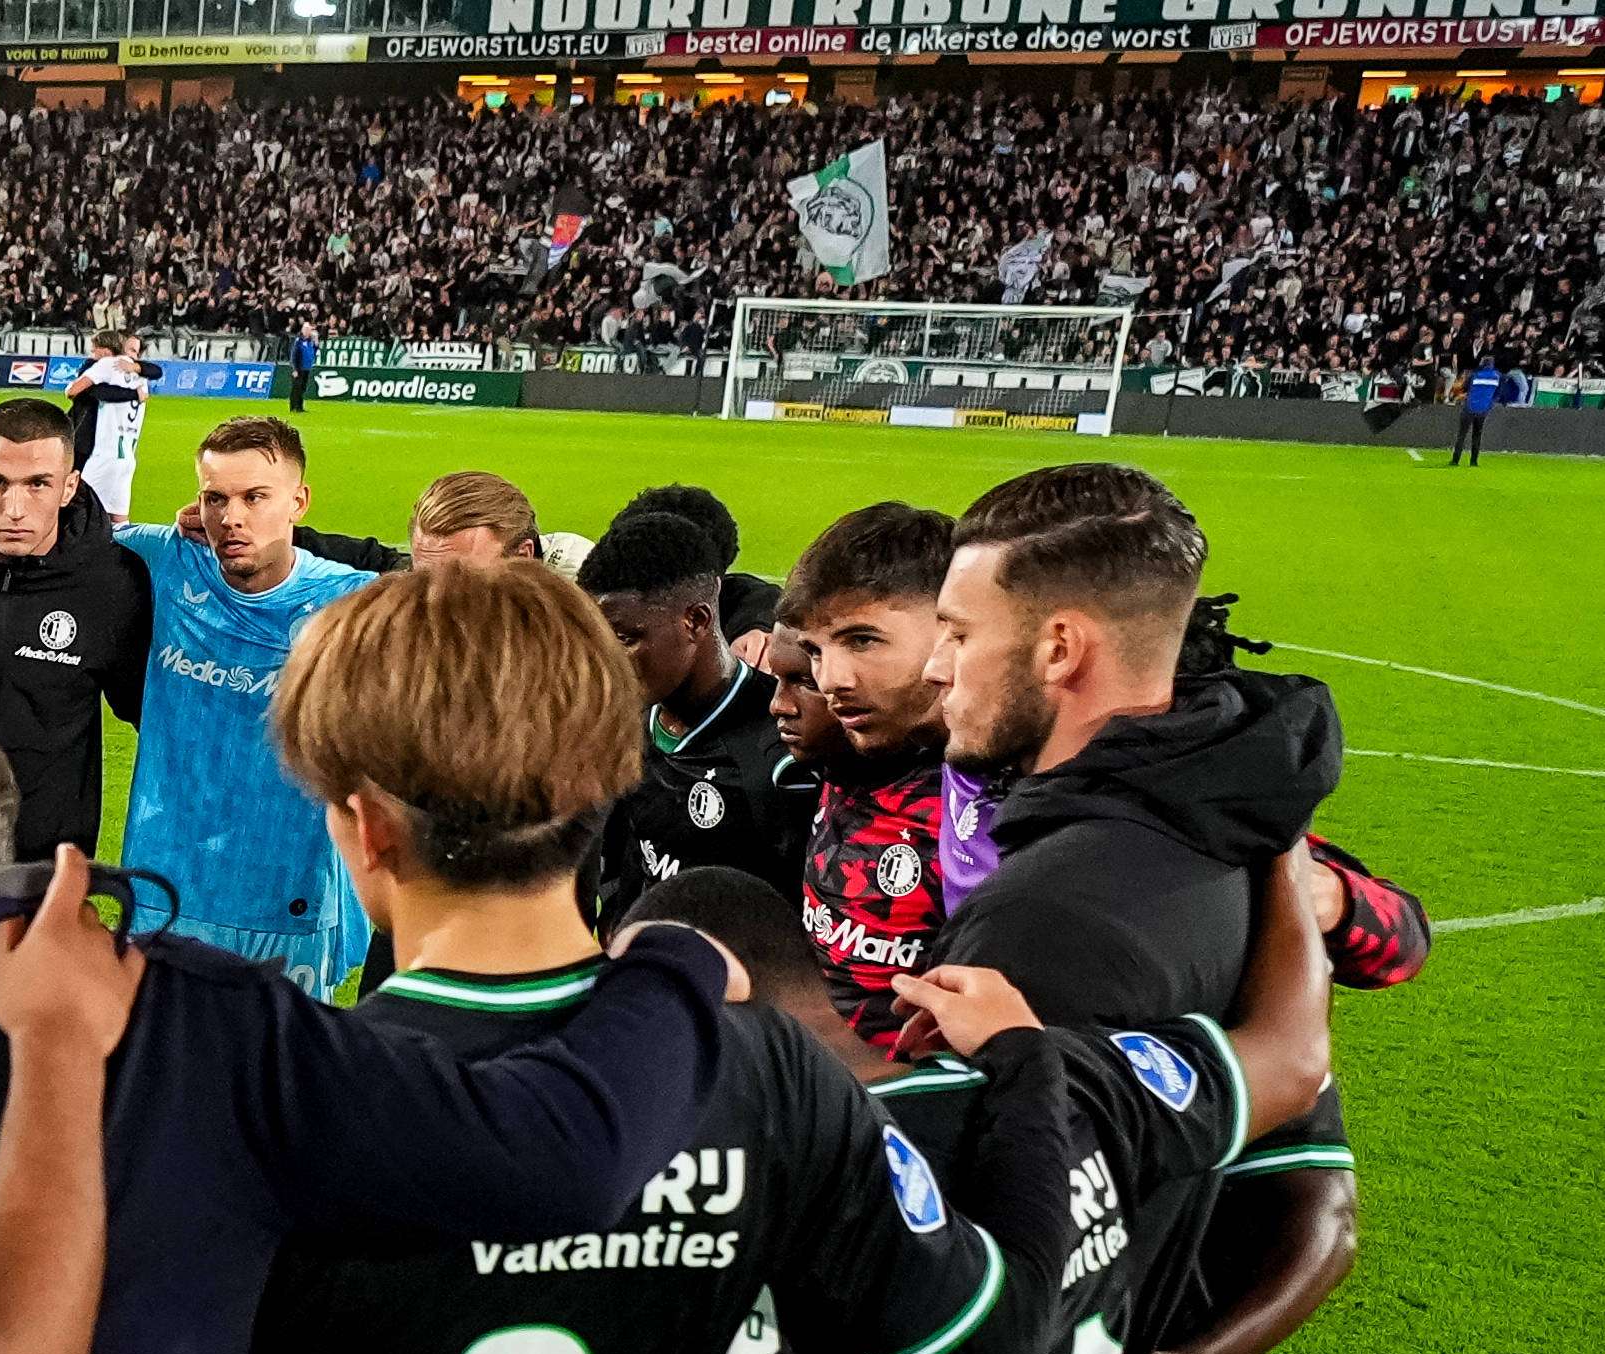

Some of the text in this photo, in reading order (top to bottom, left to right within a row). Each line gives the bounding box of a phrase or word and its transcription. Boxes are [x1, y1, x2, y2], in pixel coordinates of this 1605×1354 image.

[385, 33, 610, 58] OFJEWORSTLUST.EU
[686, 28, 761, 54] bestel
[768, 27, 847, 52] online
[861, 27, 891, 51] de
[1025, 24, 1103, 53] droge
[1111, 24, 1191, 48] worst
[235, 370, 271, 389] TFF
[351, 375, 476, 401] noordlease
[470, 1221, 739, 1276] vakanties
